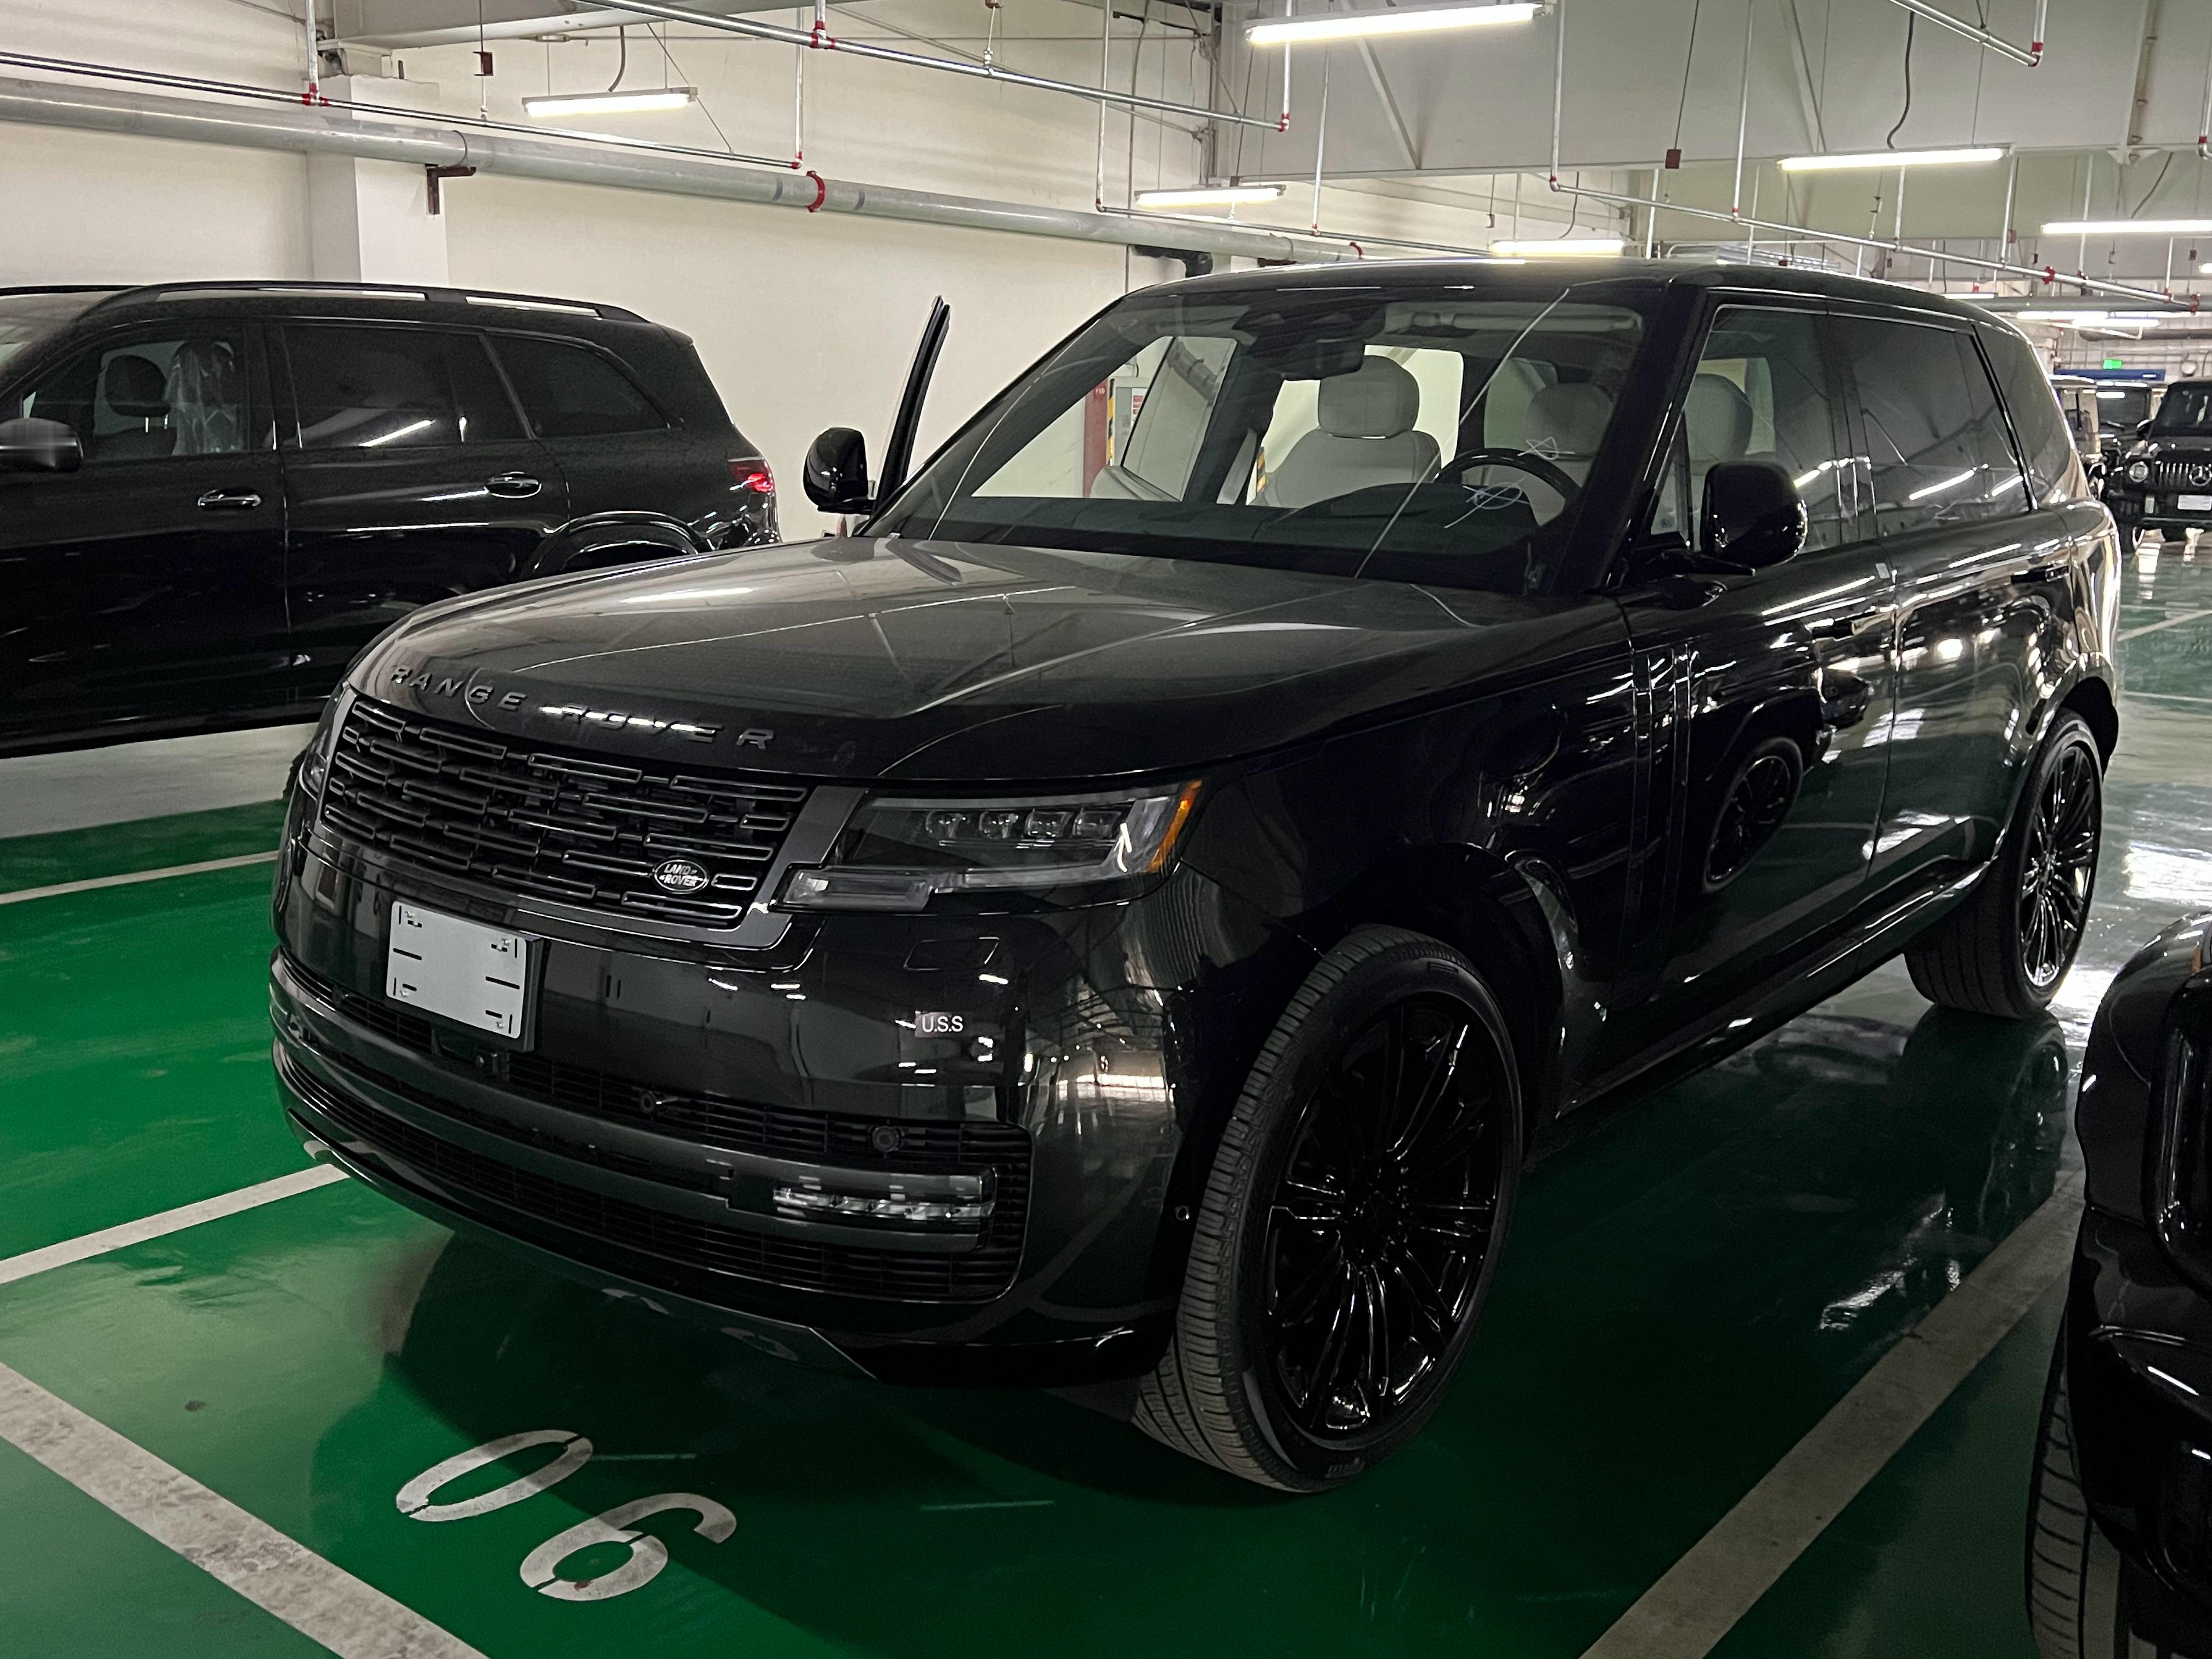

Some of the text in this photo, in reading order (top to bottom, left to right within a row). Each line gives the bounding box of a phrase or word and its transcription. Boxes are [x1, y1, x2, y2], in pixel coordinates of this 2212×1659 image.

[390, 667, 776, 750] RANGE ROVER
[663, 864, 692, 875] LAND
[663, 874, 697, 887] ROVER
[396, 1429, 737, 1601] 06
